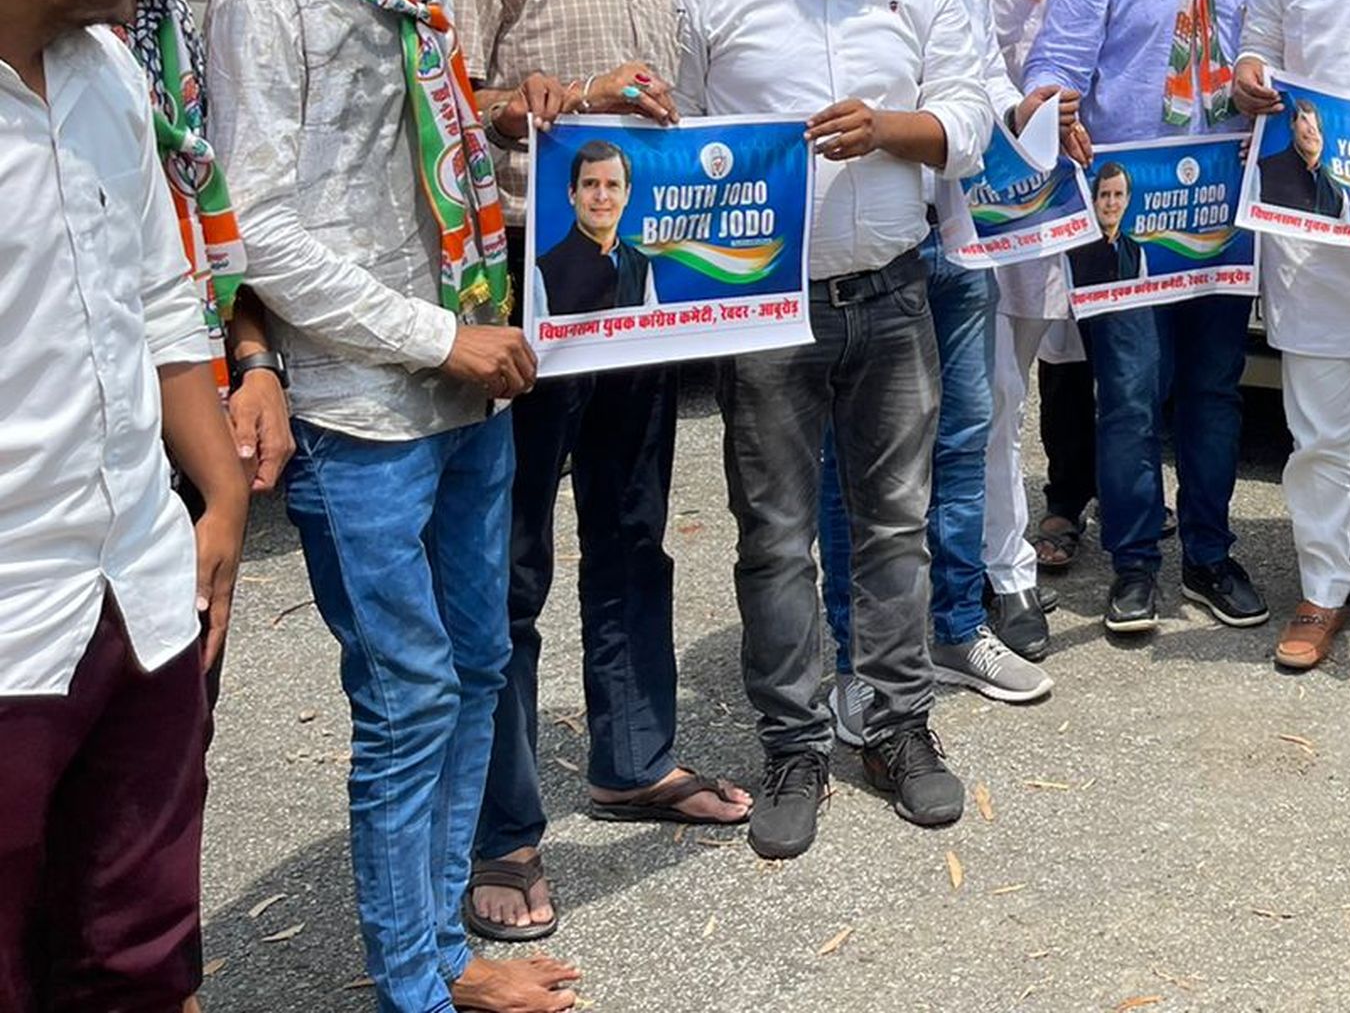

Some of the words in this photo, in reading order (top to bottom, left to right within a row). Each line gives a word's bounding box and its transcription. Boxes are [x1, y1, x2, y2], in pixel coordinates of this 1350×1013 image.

[653, 183, 713, 211] YOUTH
[719, 180, 767, 207] JODO
[1144, 189, 1189, 210] YOUTH
[1192, 184, 1226, 205] JODO
[642, 214, 712, 245] BOOTH
[718, 209, 775, 239] JODO
[1135, 212, 1187, 234] BOOTH
[1192, 204, 1229, 228] JODO
[603, 316, 634, 337] युवक
